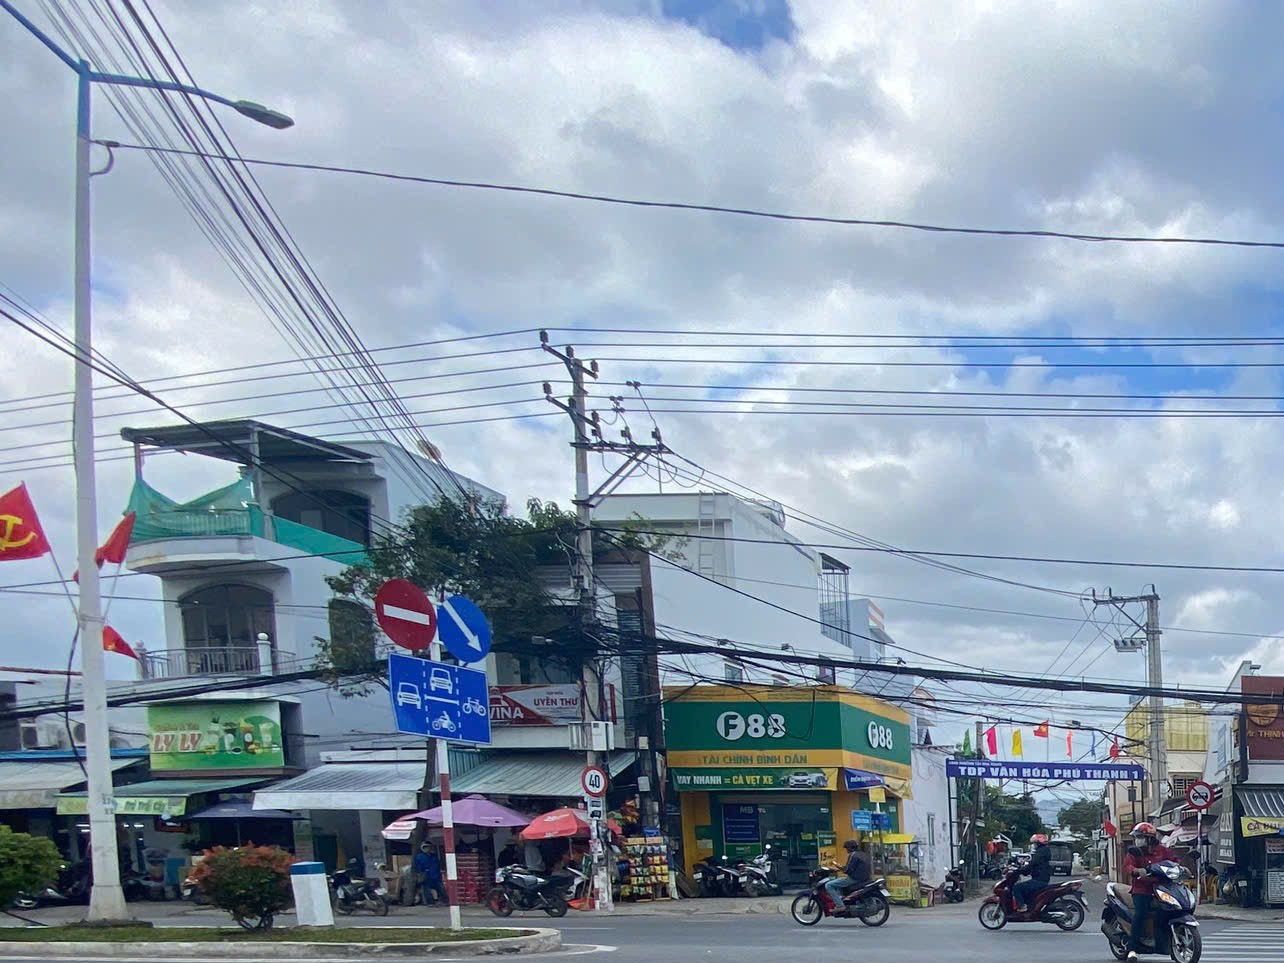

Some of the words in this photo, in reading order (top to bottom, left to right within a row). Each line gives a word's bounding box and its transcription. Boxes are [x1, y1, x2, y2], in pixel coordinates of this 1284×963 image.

[716, 711, 787, 741] F88
[152, 732, 176, 752] LY
[178, 732, 202, 752] LY
[676, 775, 691, 785] VAY
[693, 775, 722, 785] NHANH
[732, 773, 744, 785] CÀ
[745, 775, 760, 787] VẸT
[762, 775, 774, 785] XE
[958, 766, 986, 777] TDP
[1022, 767, 1050, 778] HÓA
[1132, 770, 1139, 779] 1
[589, 774, 601, 789] 40
